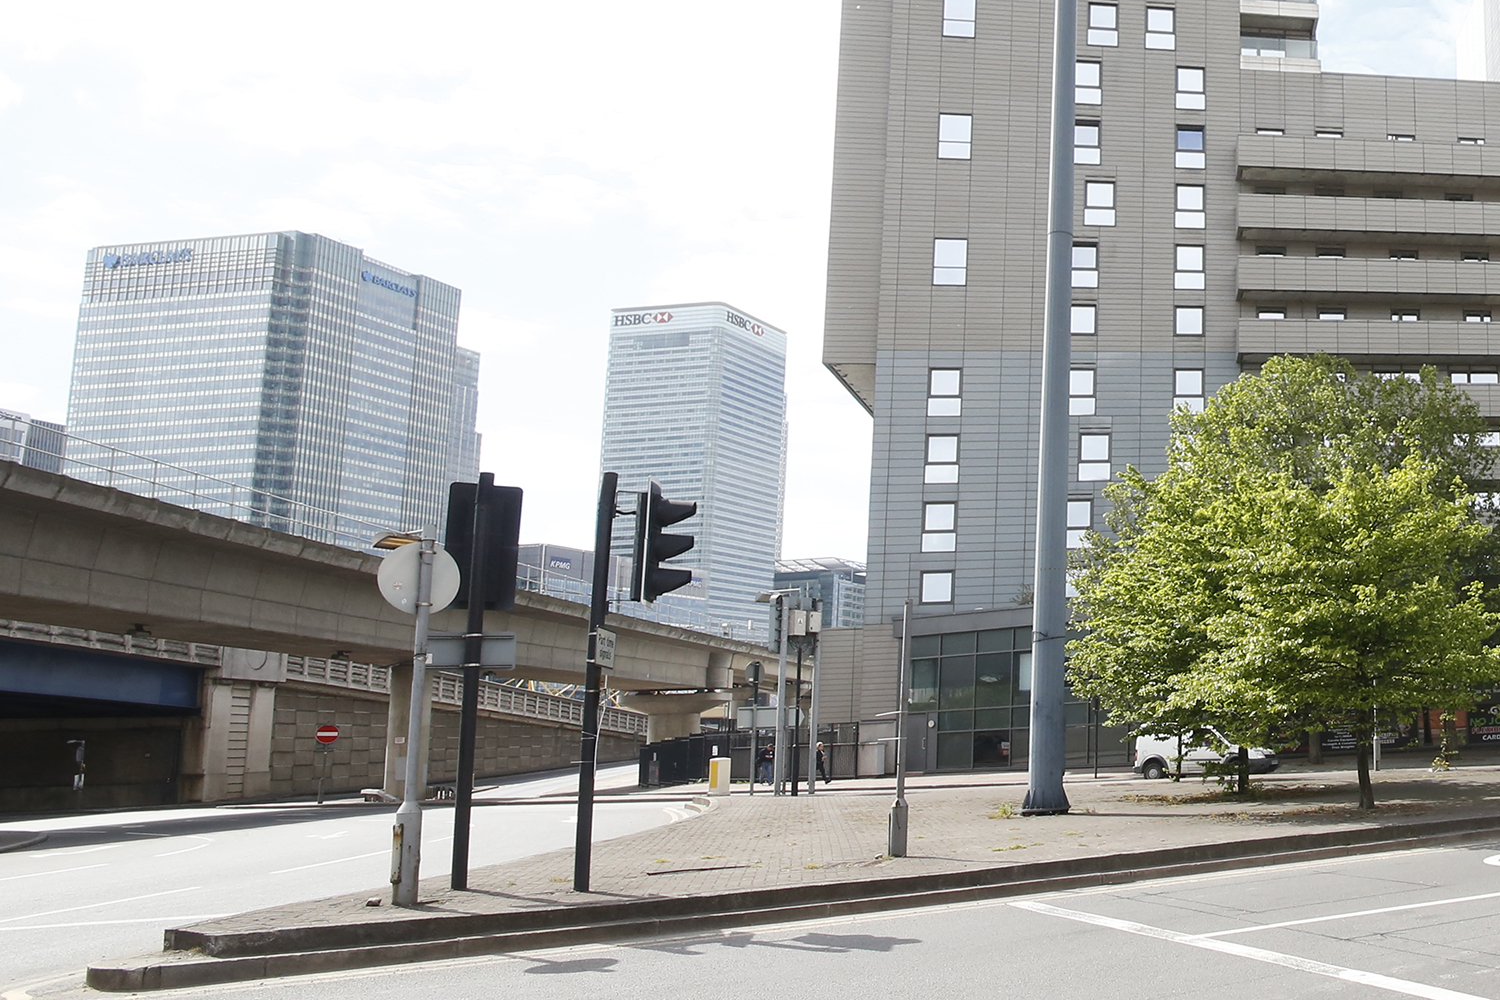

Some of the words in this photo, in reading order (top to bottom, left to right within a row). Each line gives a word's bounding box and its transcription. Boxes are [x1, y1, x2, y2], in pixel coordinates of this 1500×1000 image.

[120, 248, 193, 267] BARCLAYS
[372, 275, 418, 298] BARCLAYS
[614, 313, 652, 326] HSBC
[726, 311, 751, 331] HSBC
[550, 560, 571, 570] KPMG
[1469, 717, 1487, 727] NO
